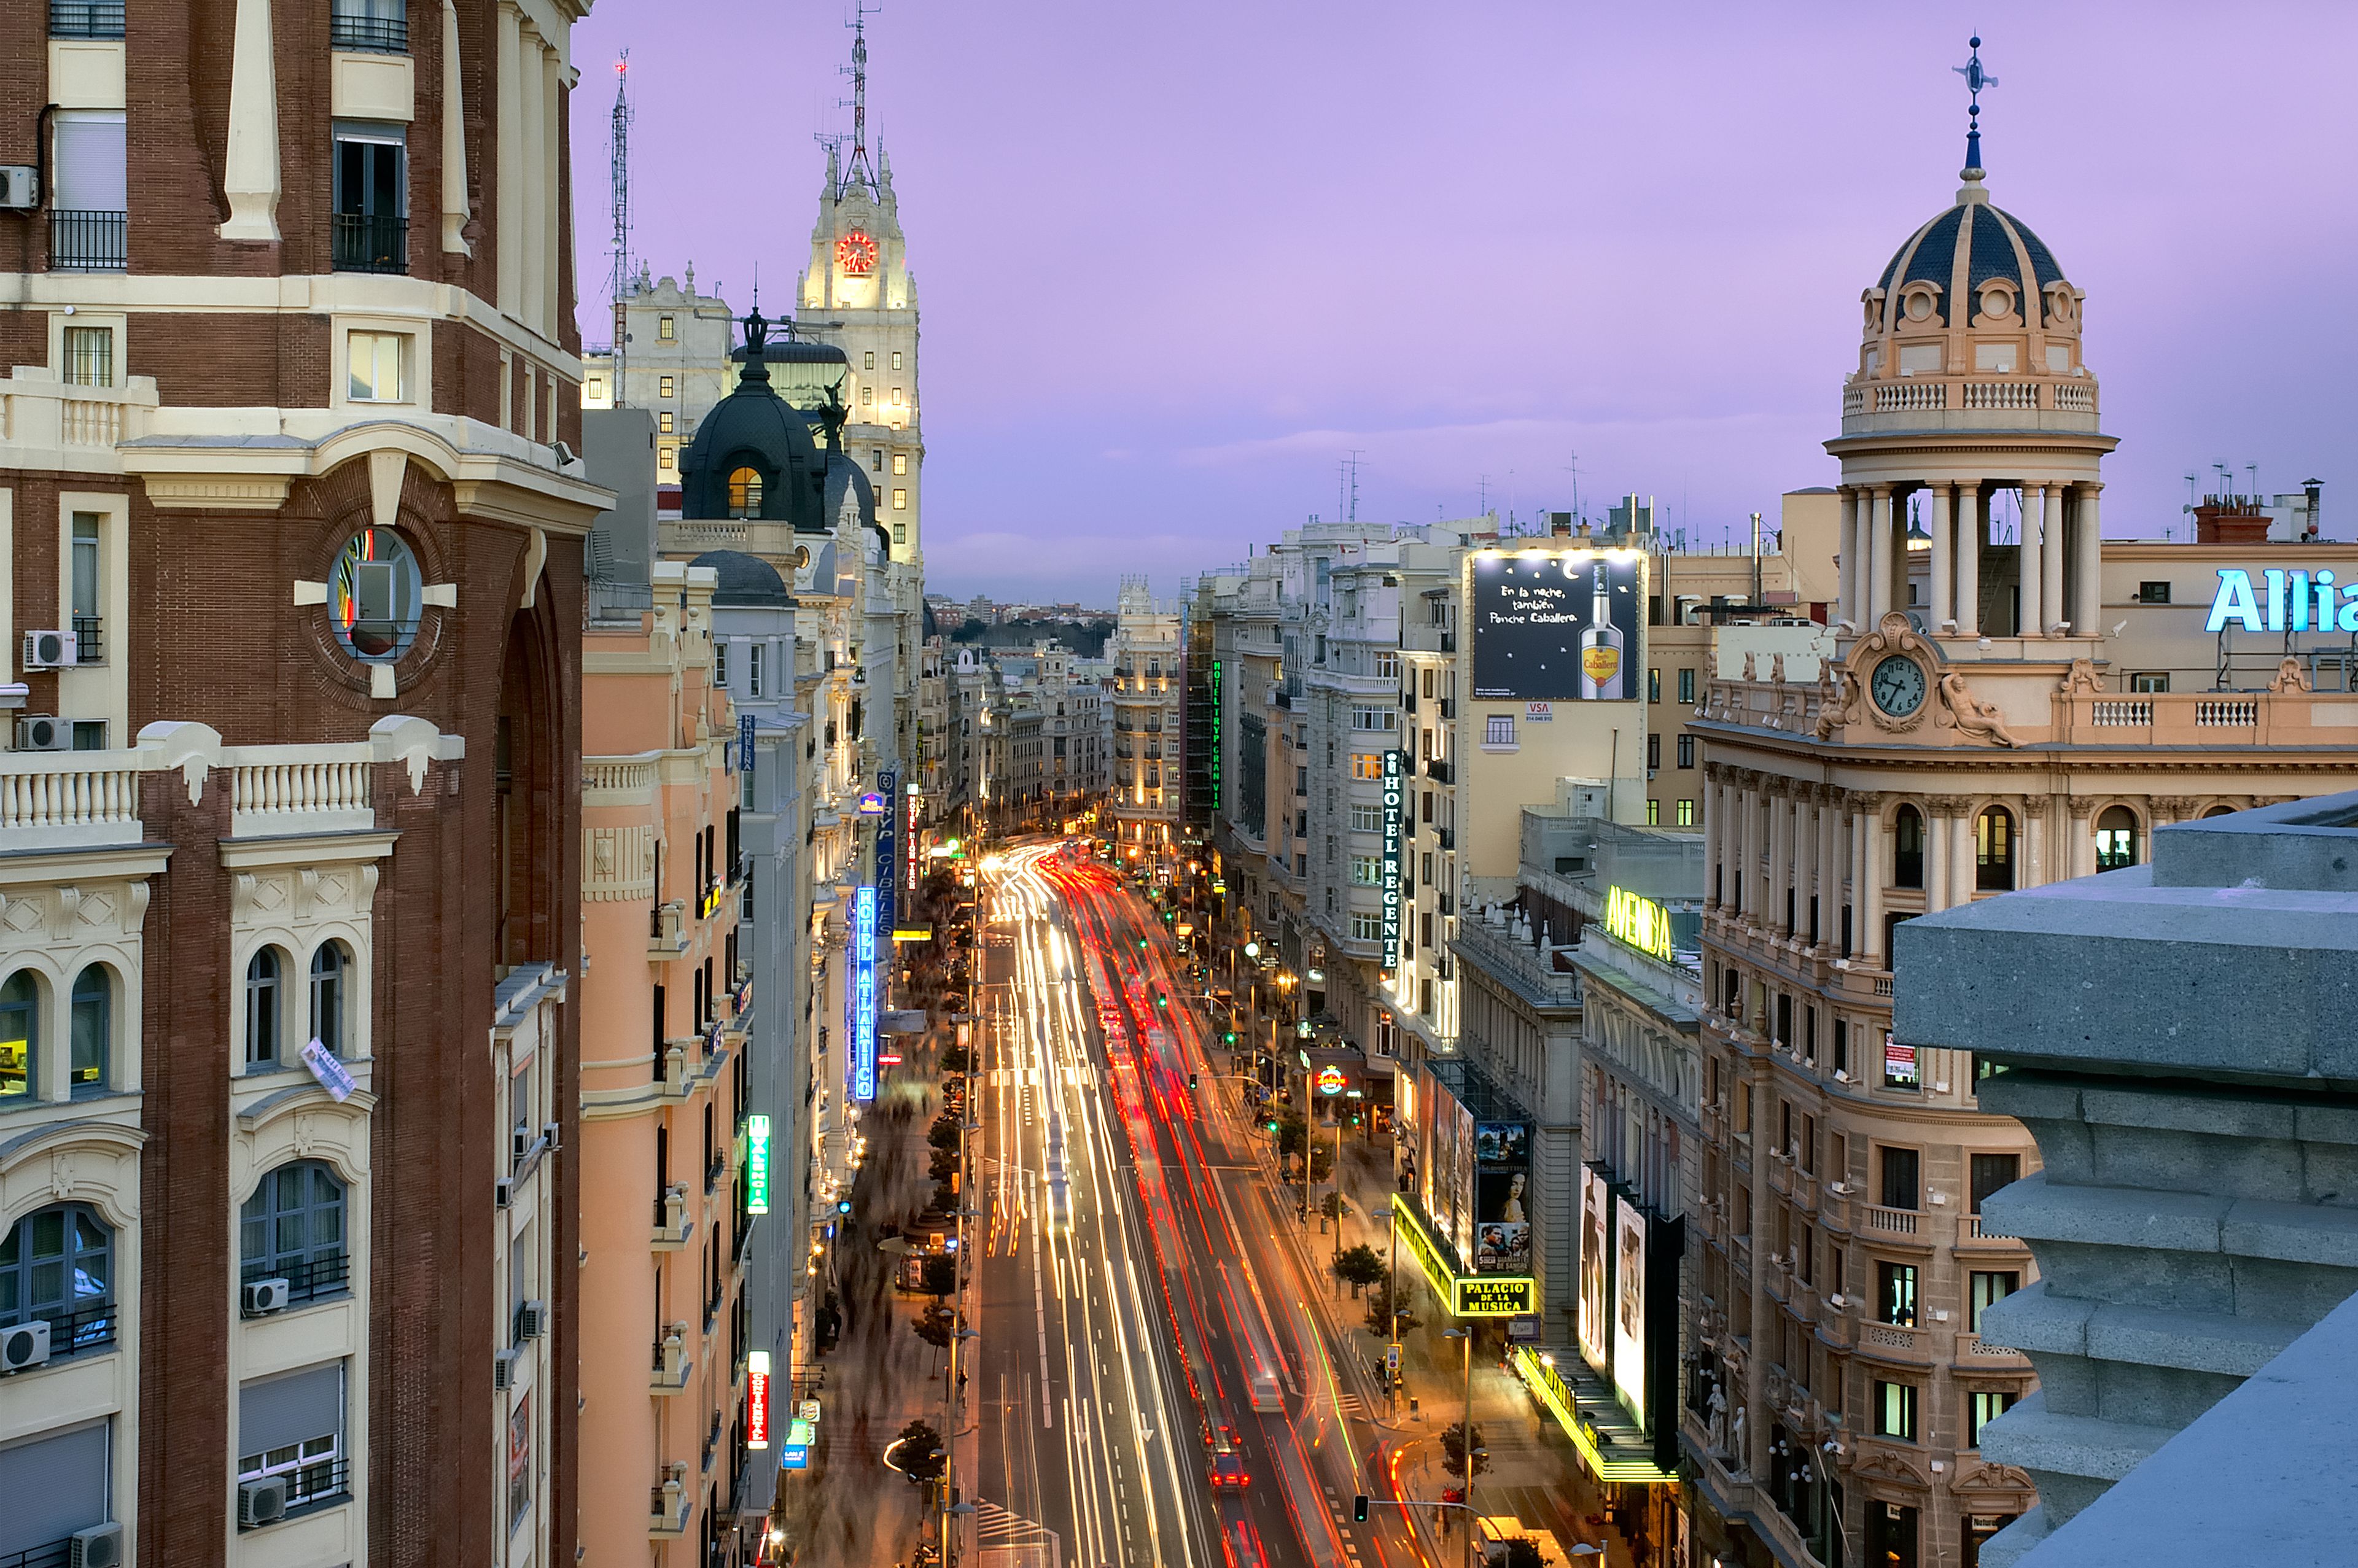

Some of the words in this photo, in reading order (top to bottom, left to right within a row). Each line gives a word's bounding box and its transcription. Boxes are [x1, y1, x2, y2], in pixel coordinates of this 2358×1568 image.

[1501, 585, 1515, 597] En
[1519, 586, 1530, 597] la
[1533, 588, 1566, 599] noche,
[1512, 599, 1554, 610] también
[1490, 612, 1525, 624] Ponche
[1530, 612, 1578, 624] Caballero.
[1584, 659, 1617, 669] Caballero
[1888, 664, 1894, 673] 11
[1896, 662, 1904, 671] 12
[1913, 673, 1919, 682] 2
[1878, 681, 1883, 690] 9
[1917, 682, 1922, 691] 3
[1912, 693, 1918, 701] 4
[1897, 702, 1902, 711] 6
[1907, 699, 1913, 708] 5
[1383, 777, 1400, 853] HOTEL
[878, 854, 893, 937] CIBELES
[1383, 860, 1398, 968] REGENTE
[859, 891, 872, 961] HOTEL
[1606, 884, 1672, 962] AVENIDA
[858, 969, 871, 1096] ATLANTICO
[1466, 1284, 1525, 1294] PALACIO
[1468, 1301, 1522, 1311] MUSICA
